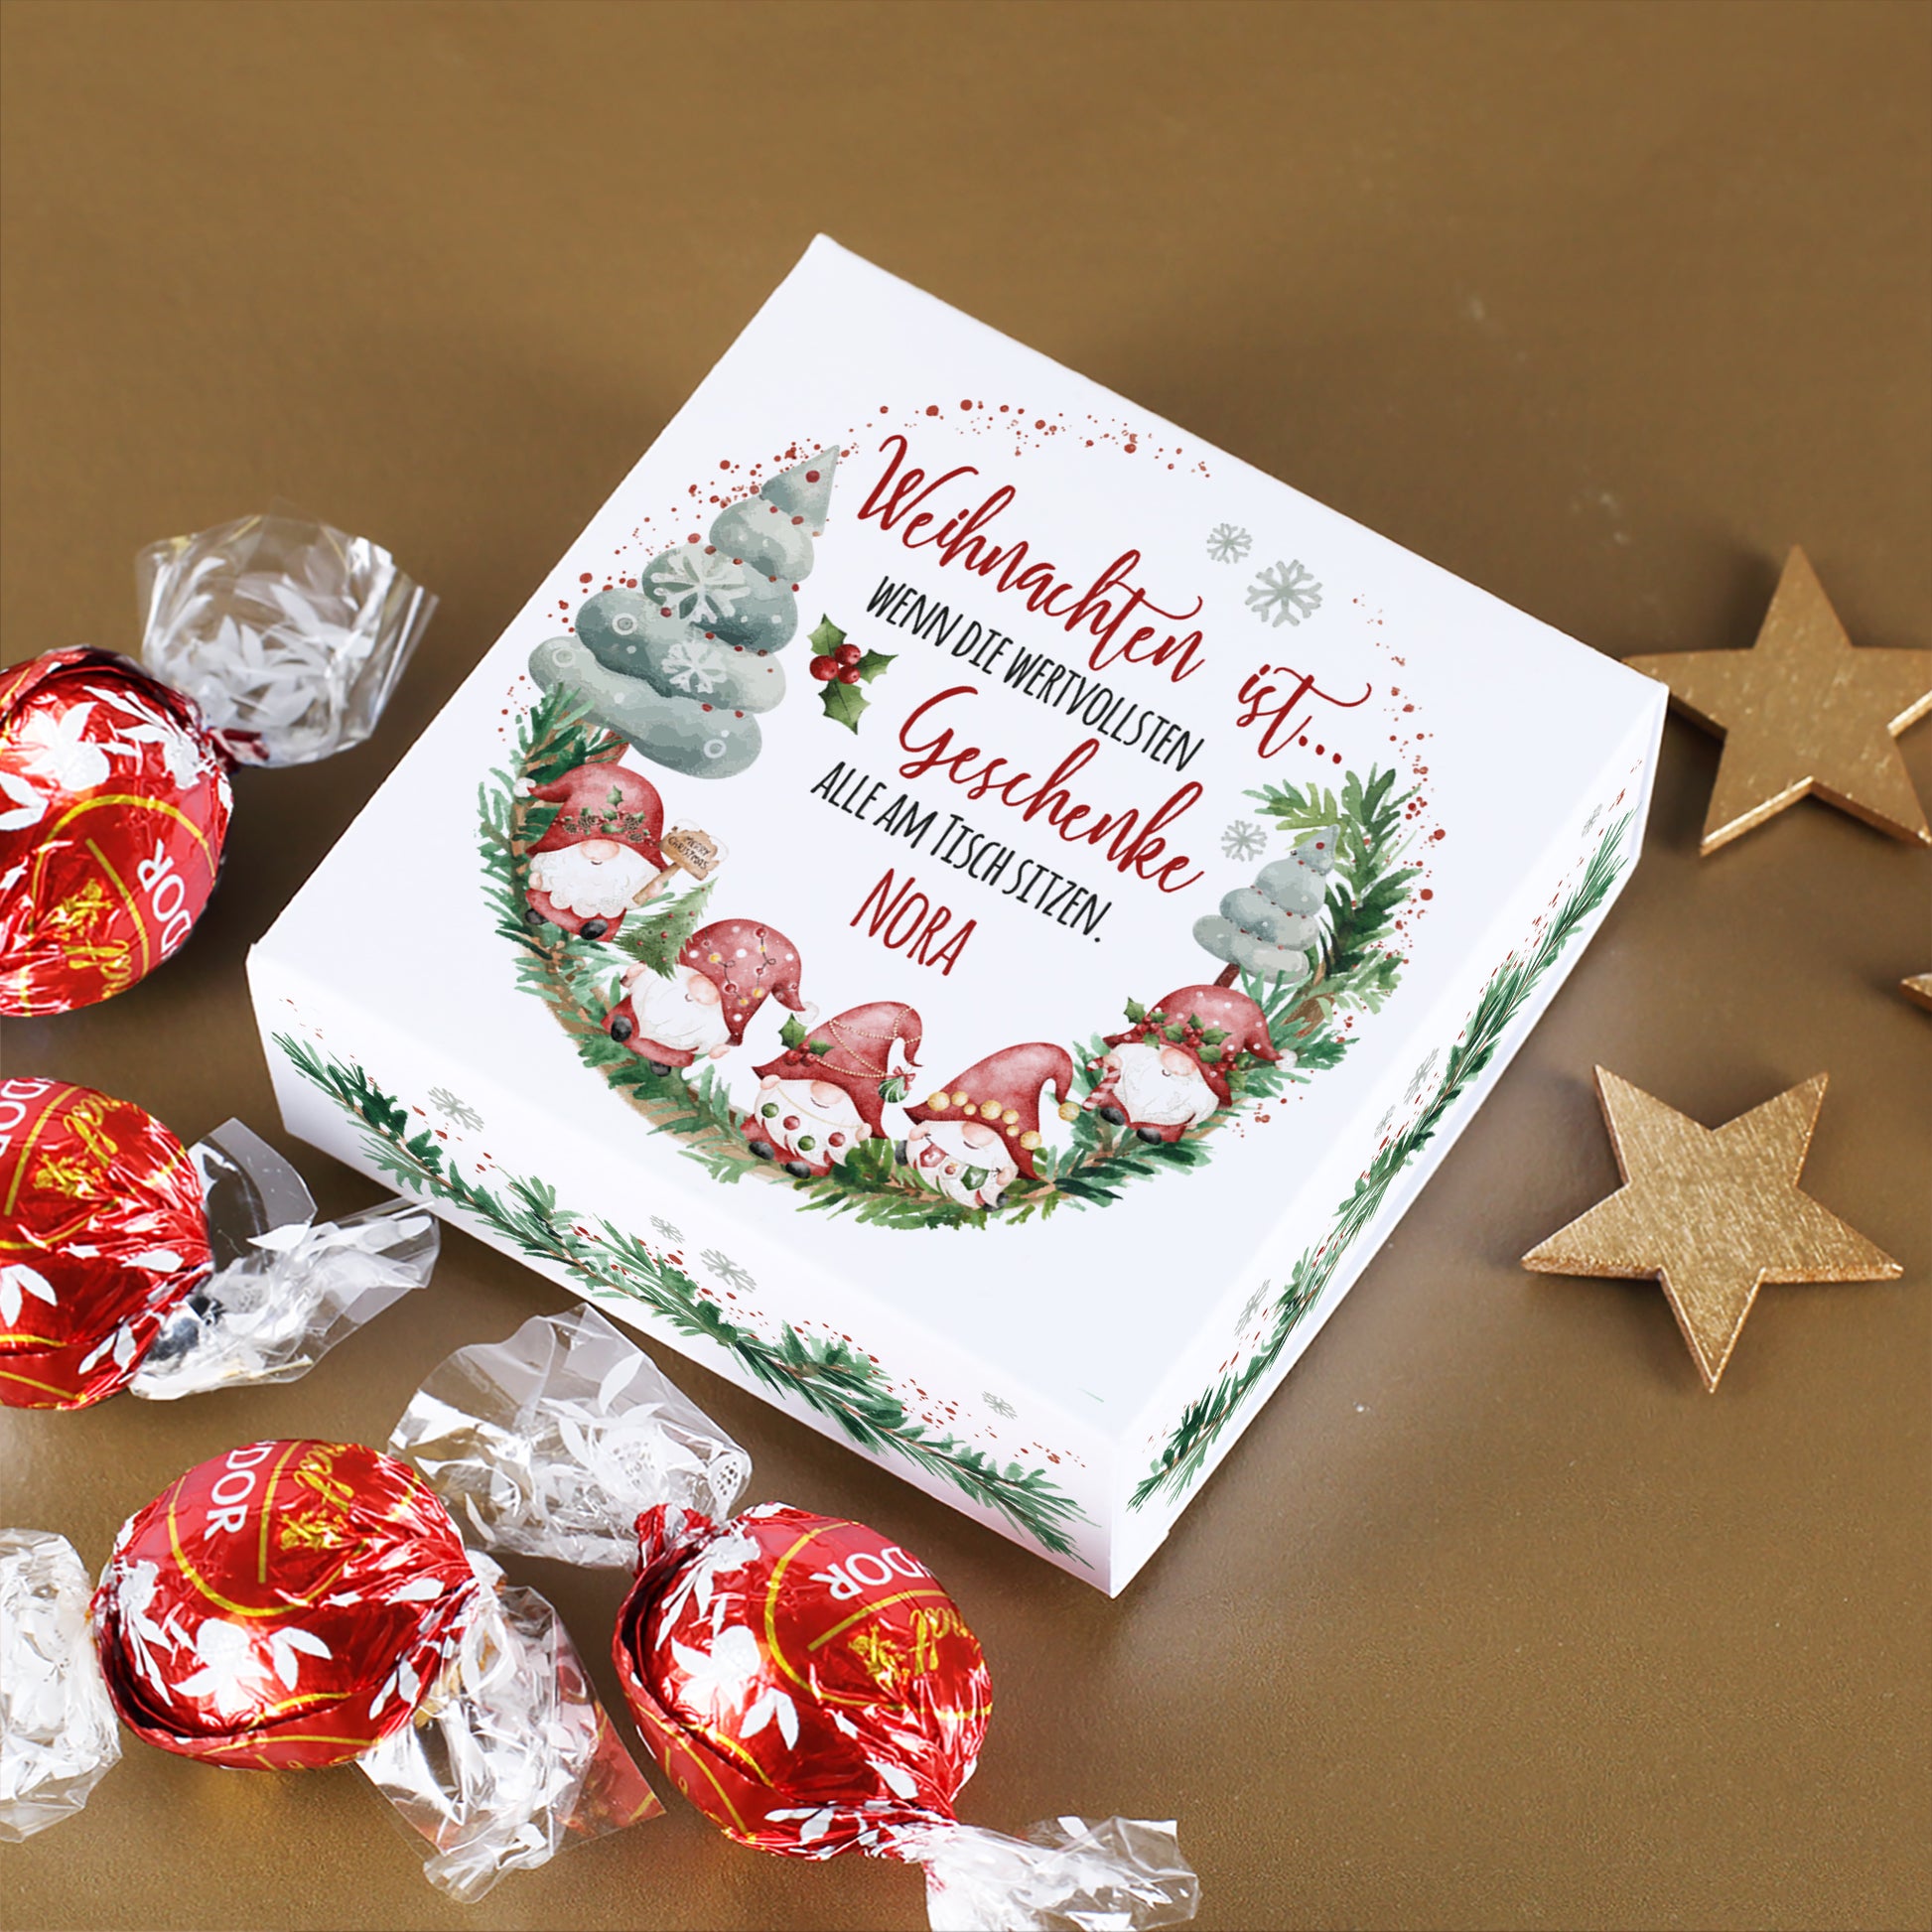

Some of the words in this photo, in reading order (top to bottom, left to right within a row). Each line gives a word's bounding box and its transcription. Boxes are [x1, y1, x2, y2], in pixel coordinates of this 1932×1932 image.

[857, 434, 1205, 683] Weihnachten
[866, 575, 964, 647] WENN
[950, 621, 1014, 675] DIE
[1003, 646, 1205, 772] WERTVOLLSTEN
[809, 760, 888, 820] ALLE
[872, 793, 938, 849] AM
[929, 813, 1016, 887] TISCH
[1002, 859, 1112, 943] SITZEN.
[898, 685, 1205, 894] Geschenke
[137, 837, 193, 960] DOR
[849, 868, 978, 976] NORA
[204, 1441, 277, 1541] DOR
[808, 1546, 932, 1601] DOR
